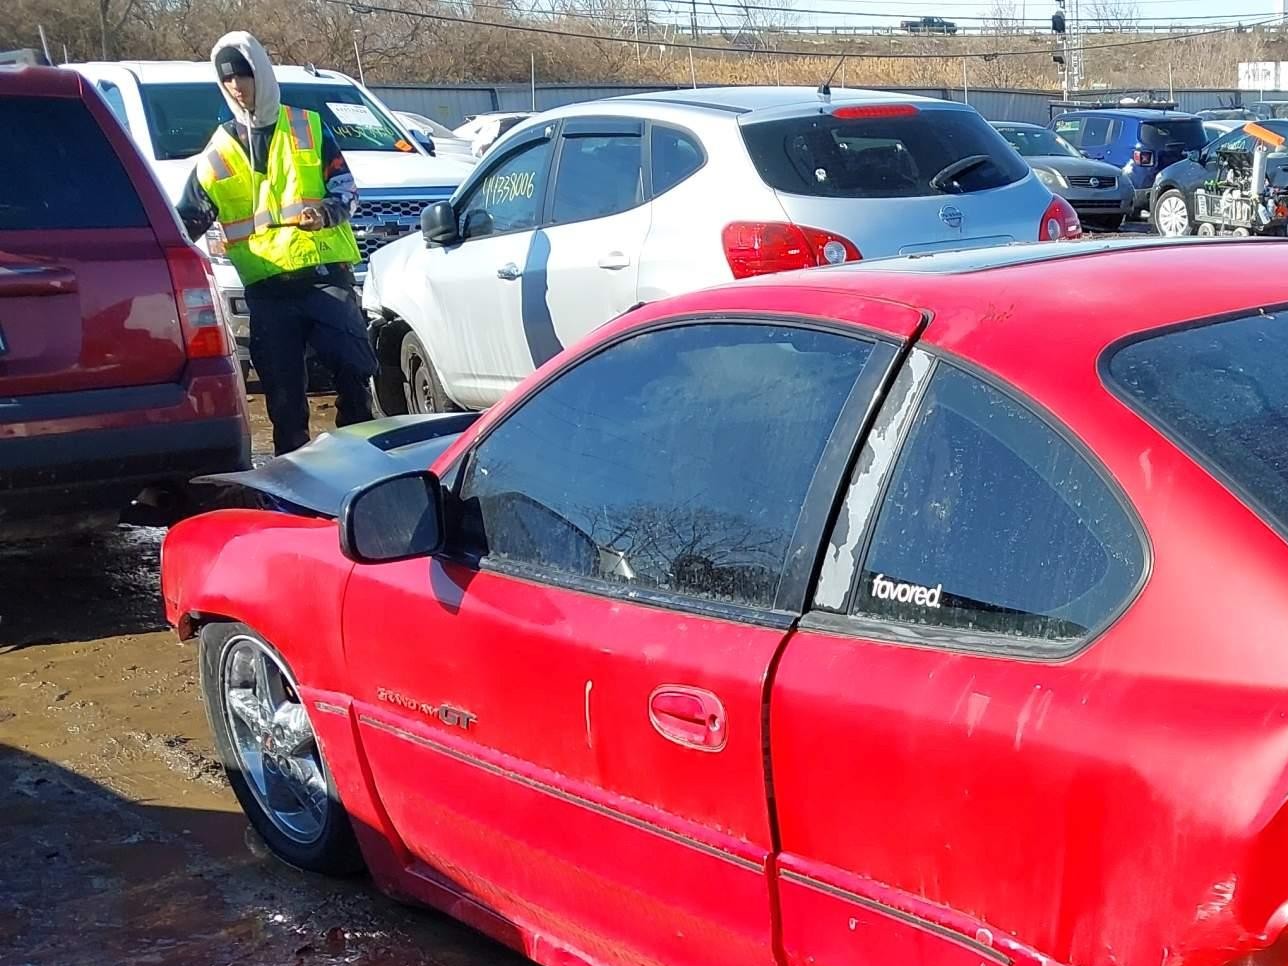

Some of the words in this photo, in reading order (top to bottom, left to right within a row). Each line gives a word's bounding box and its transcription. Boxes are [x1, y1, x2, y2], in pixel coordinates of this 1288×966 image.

[482, 171, 536, 209] 44338006
[871, 573, 943, 609] favored.
[438, 702, 478, 730] GT
